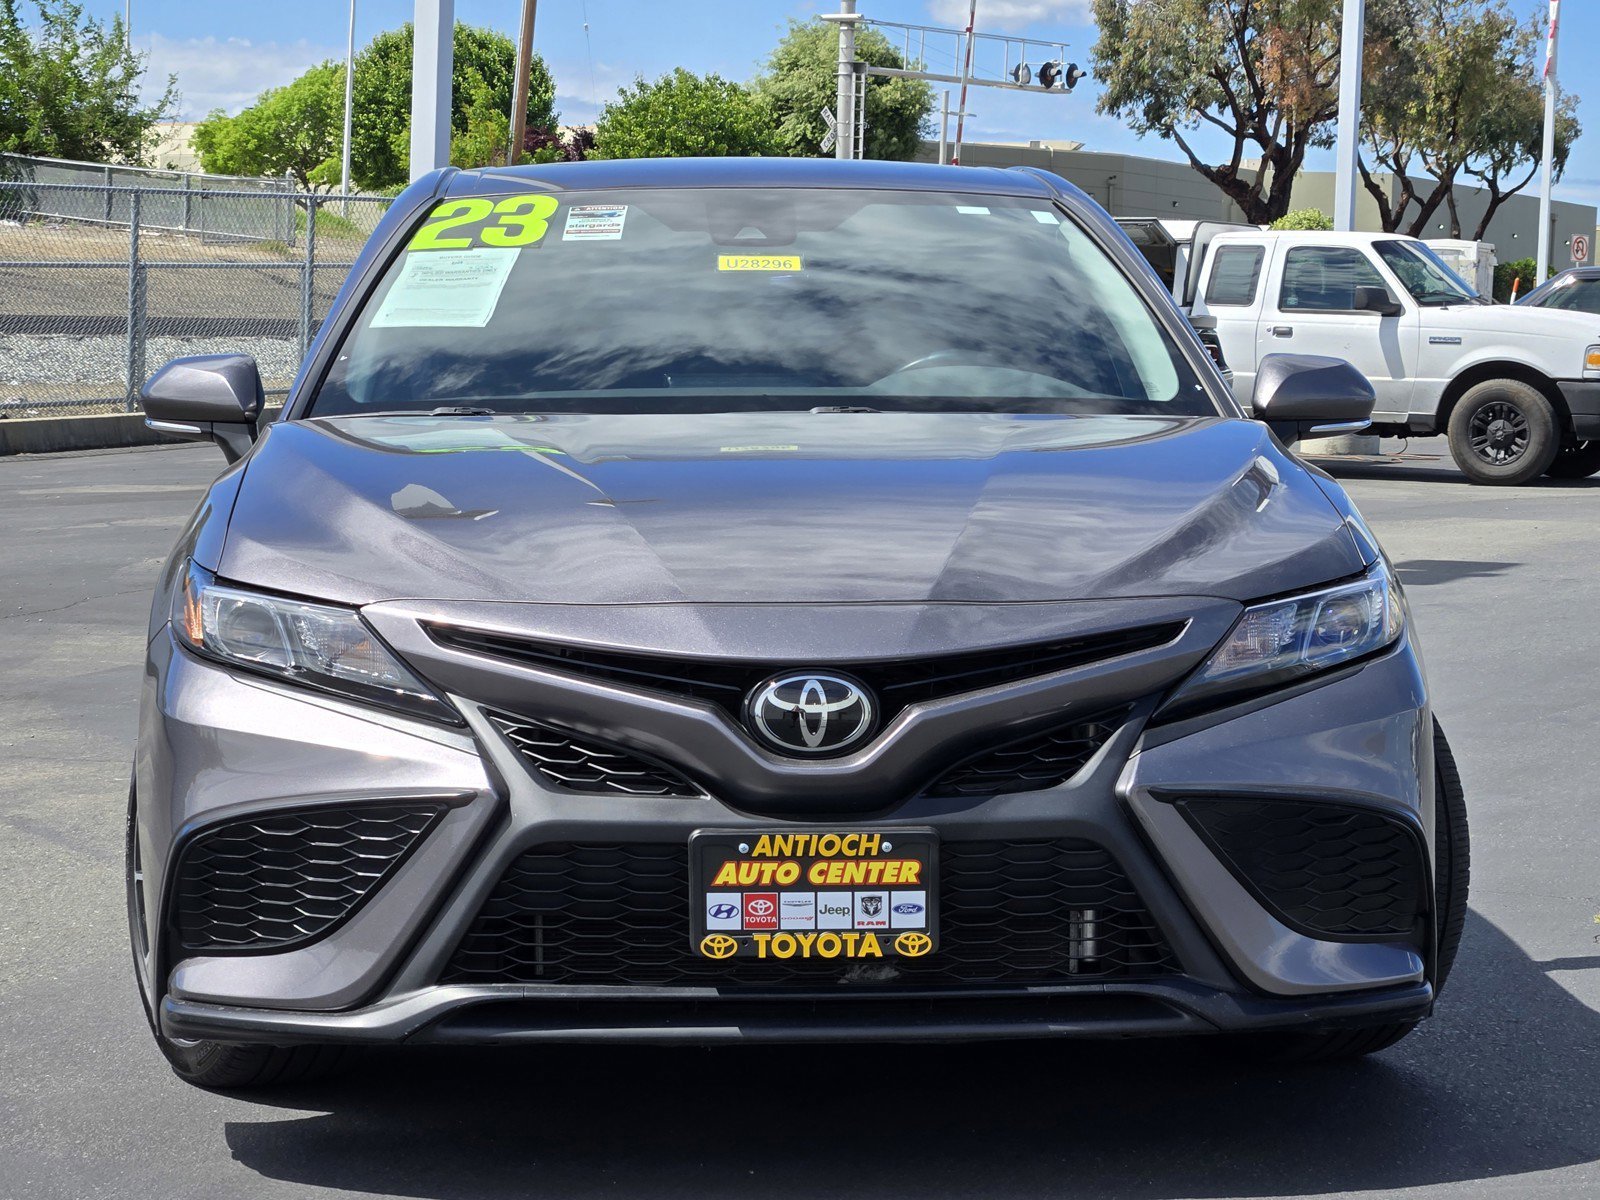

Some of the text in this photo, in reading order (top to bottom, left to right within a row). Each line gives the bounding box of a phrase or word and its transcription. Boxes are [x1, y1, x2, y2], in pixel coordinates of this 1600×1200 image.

[408, 194, 558, 251] 23
[726, 259, 793, 270] U28296
[751, 833, 881, 858] ANTIOCH
[711, 859, 922, 887] AUTO CENTER
[819, 904, 850, 917] Jeep
[898, 904, 918, 913] Ford
[752, 931, 884, 959] TOYOTA
